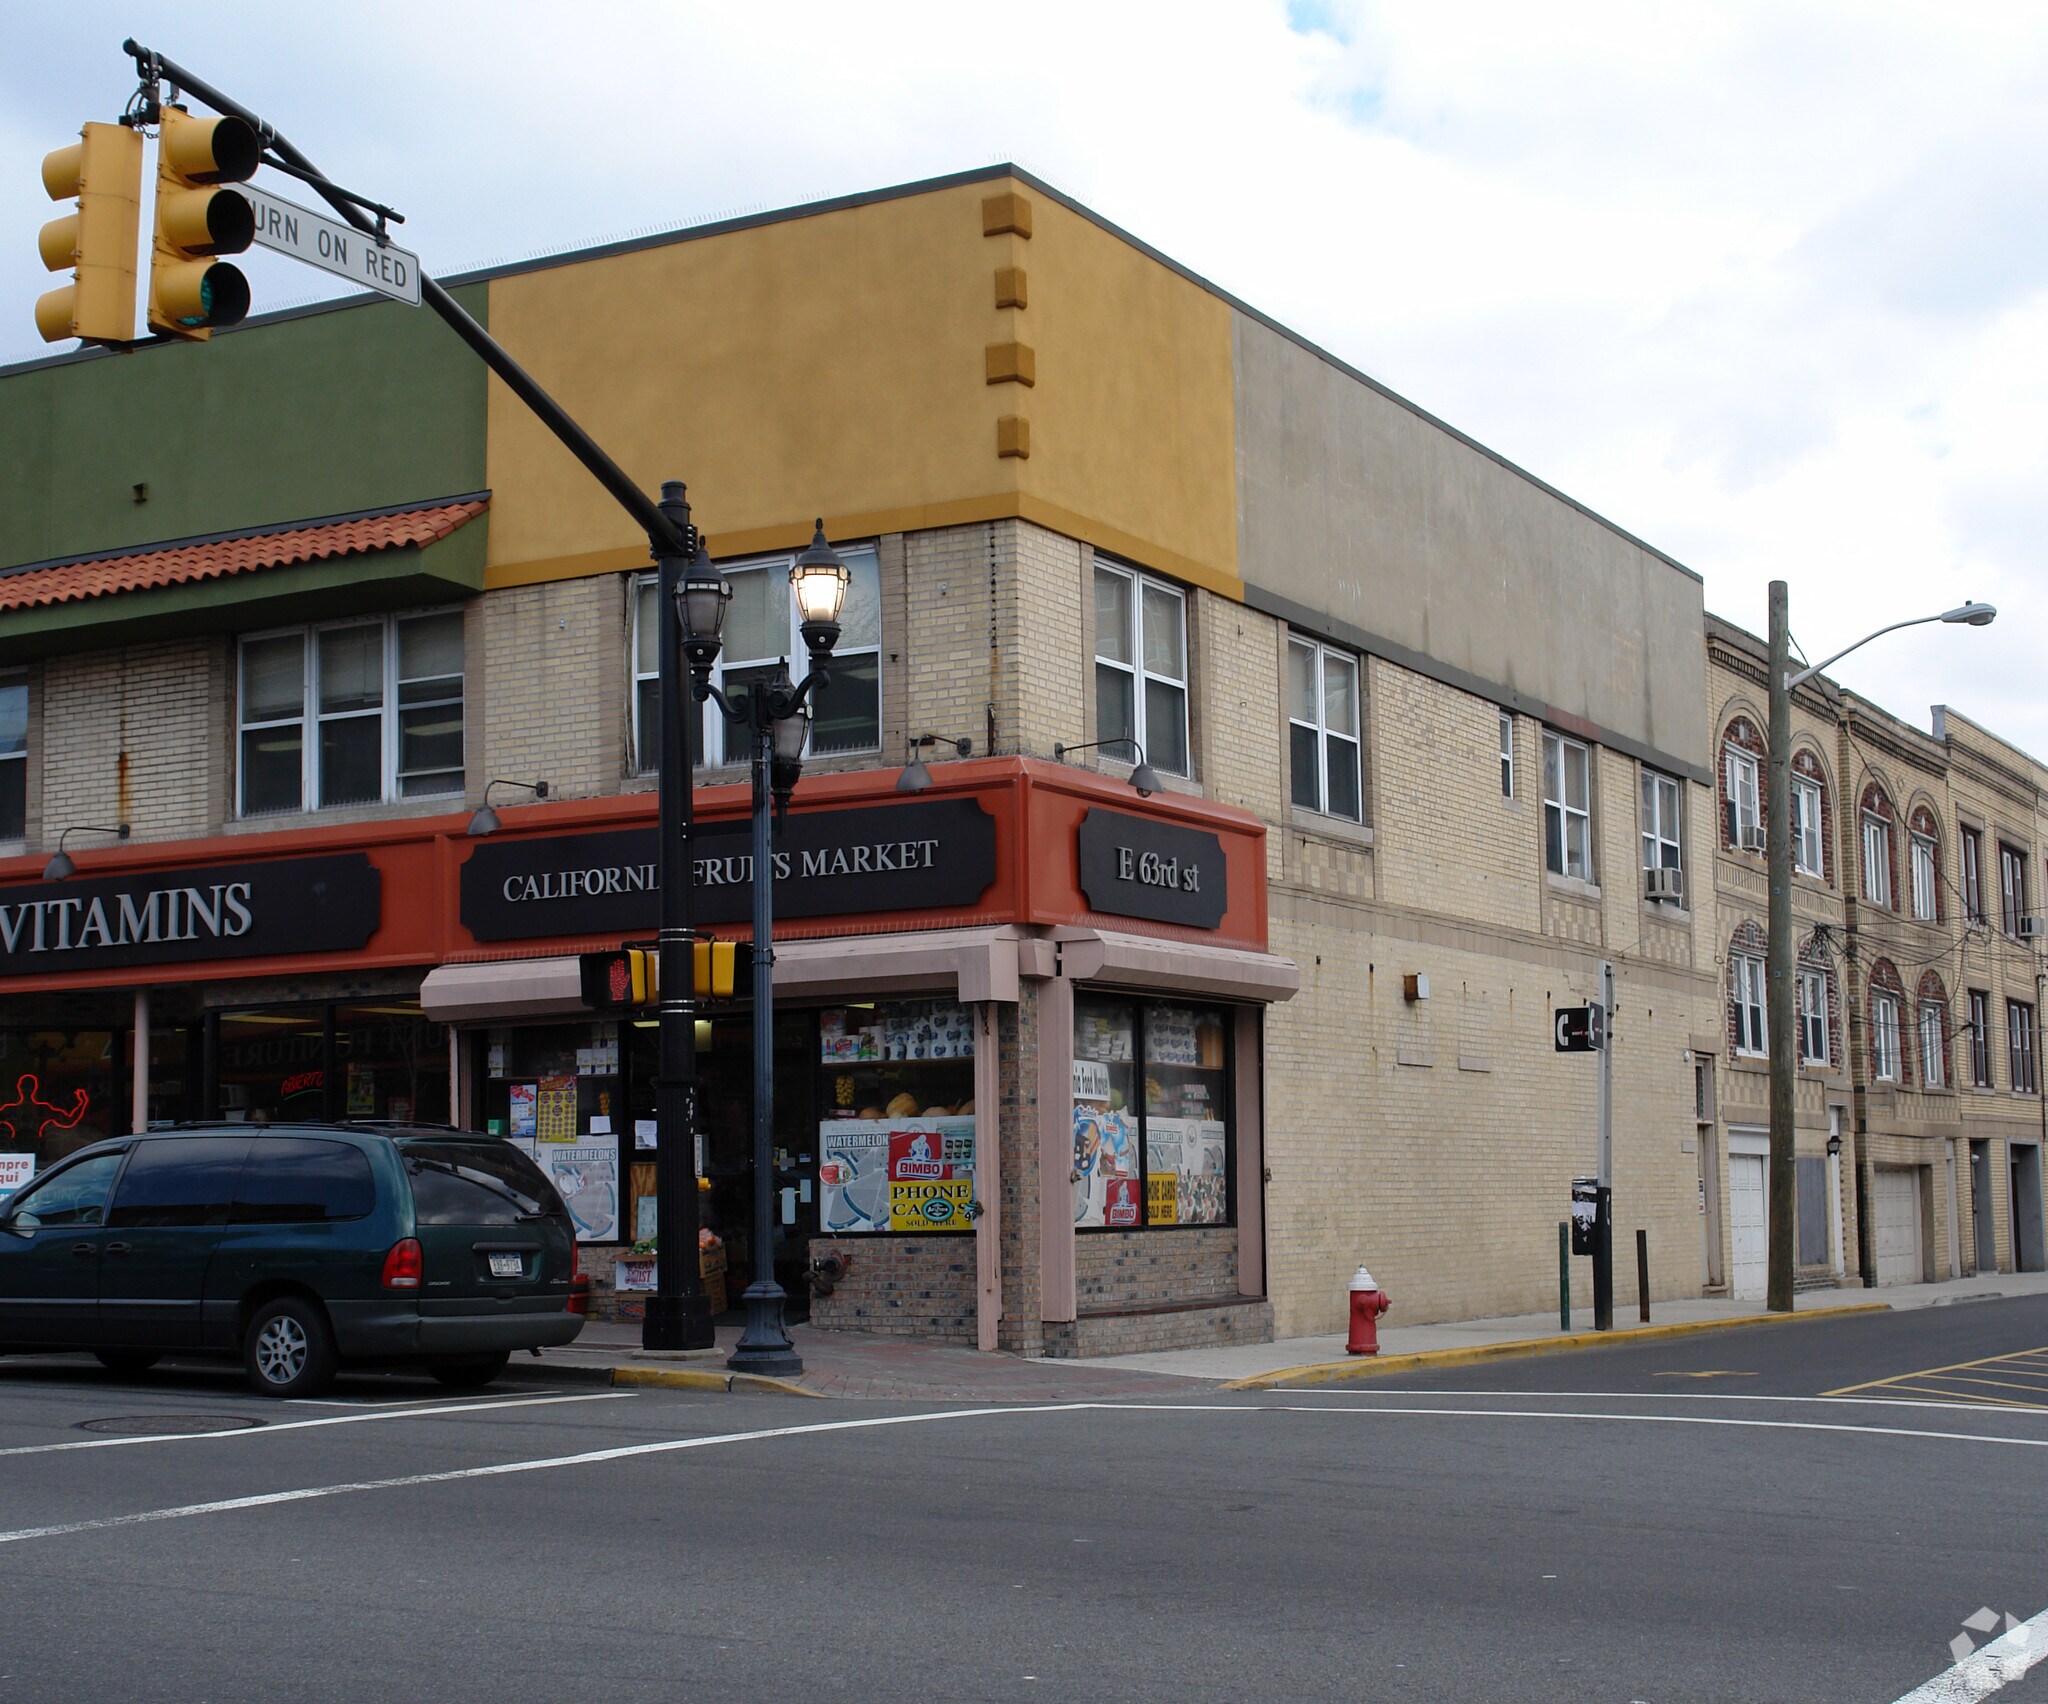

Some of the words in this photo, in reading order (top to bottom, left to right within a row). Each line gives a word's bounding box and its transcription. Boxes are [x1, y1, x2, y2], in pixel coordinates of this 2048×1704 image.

[250, 199, 298, 246] URN
[318, 229, 347, 265] ON
[366, 248, 406, 287] RED
[503, 863, 660, 901] CALIFORNI
[801, 840, 939, 878] MARKET
[1117, 847, 1134, 880] E
[1139, 852, 1178, 888] 63rd
[1183, 864, 1200, 892] st
[0, 883, 252, 953] VITAMINS
[552, 1148, 616, 1162] WATERMELONS
[900, 1163, 940, 1175] BIMBO
[893, 1185, 969, 1199] PHONE
[893, 1202, 966, 1216] CAS
[1111, 1208, 1135, 1219] BIMBO
[905, 1219, 929, 1227] SOLD
